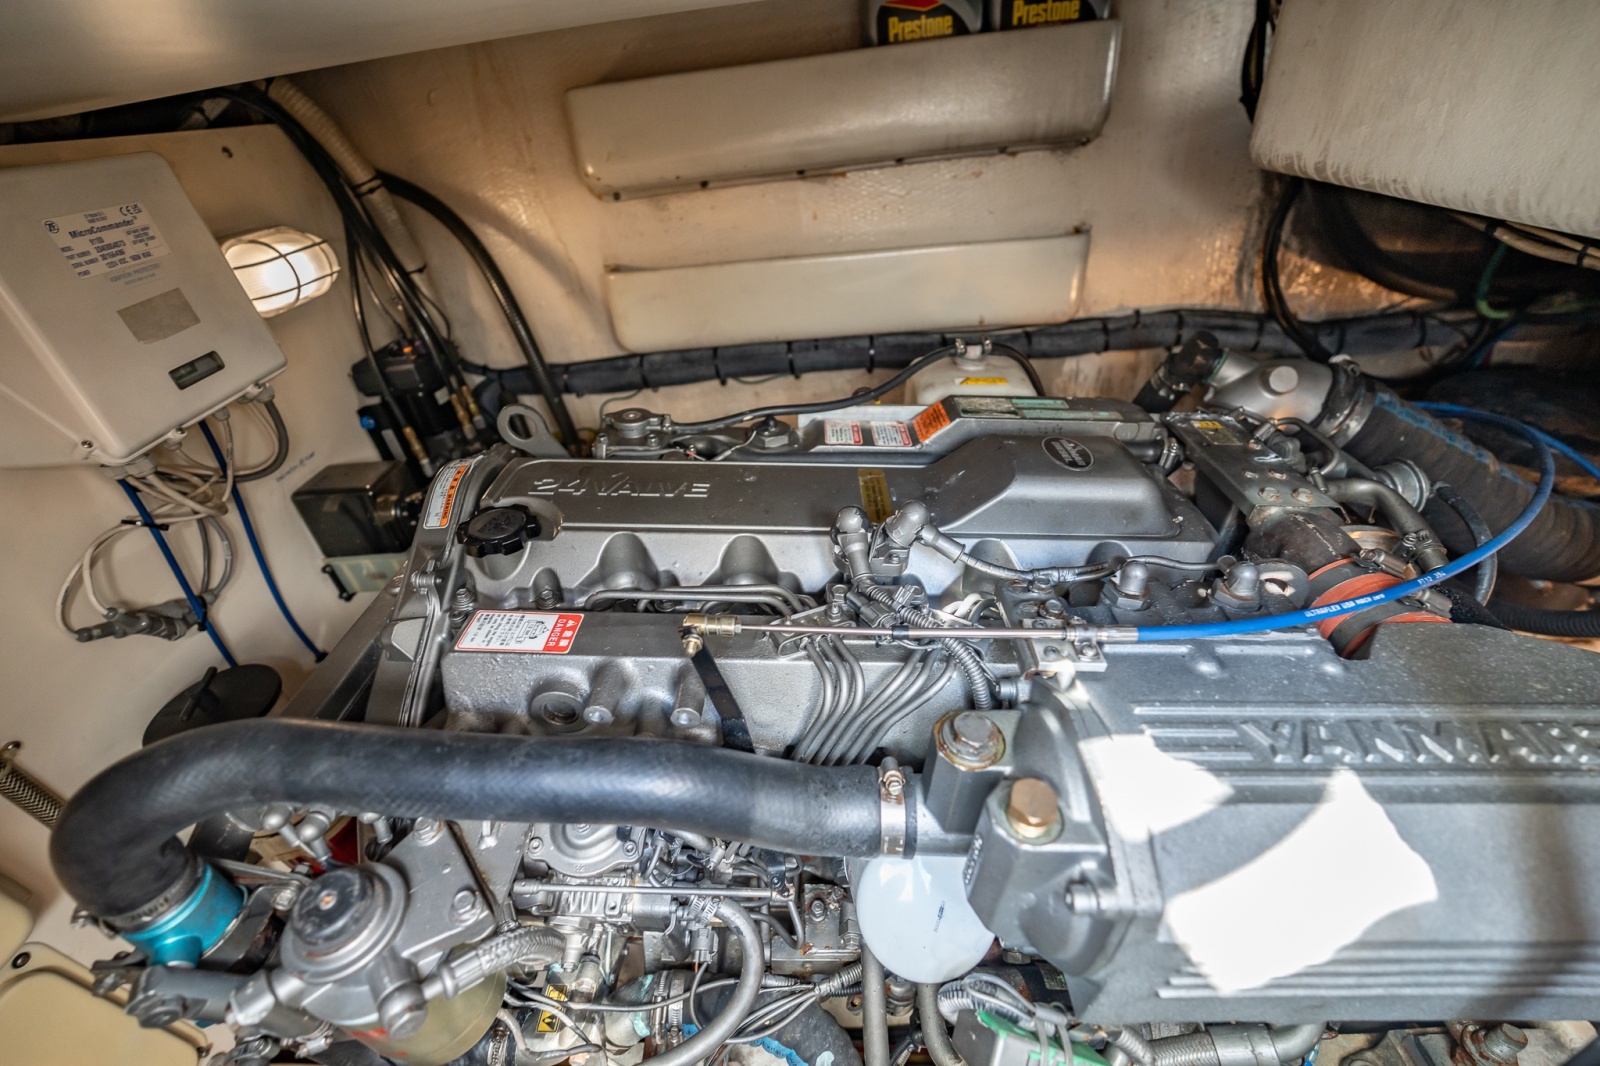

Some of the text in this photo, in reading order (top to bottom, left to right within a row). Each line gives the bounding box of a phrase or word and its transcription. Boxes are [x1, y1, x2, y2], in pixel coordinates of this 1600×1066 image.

[888, 15, 953, 43] Prestone
[528, 473, 711, 497] 24 VALVE
[1303, 604, 1341, 617] ULTRAFLEX
[546, 618, 567, 647] DANGER
